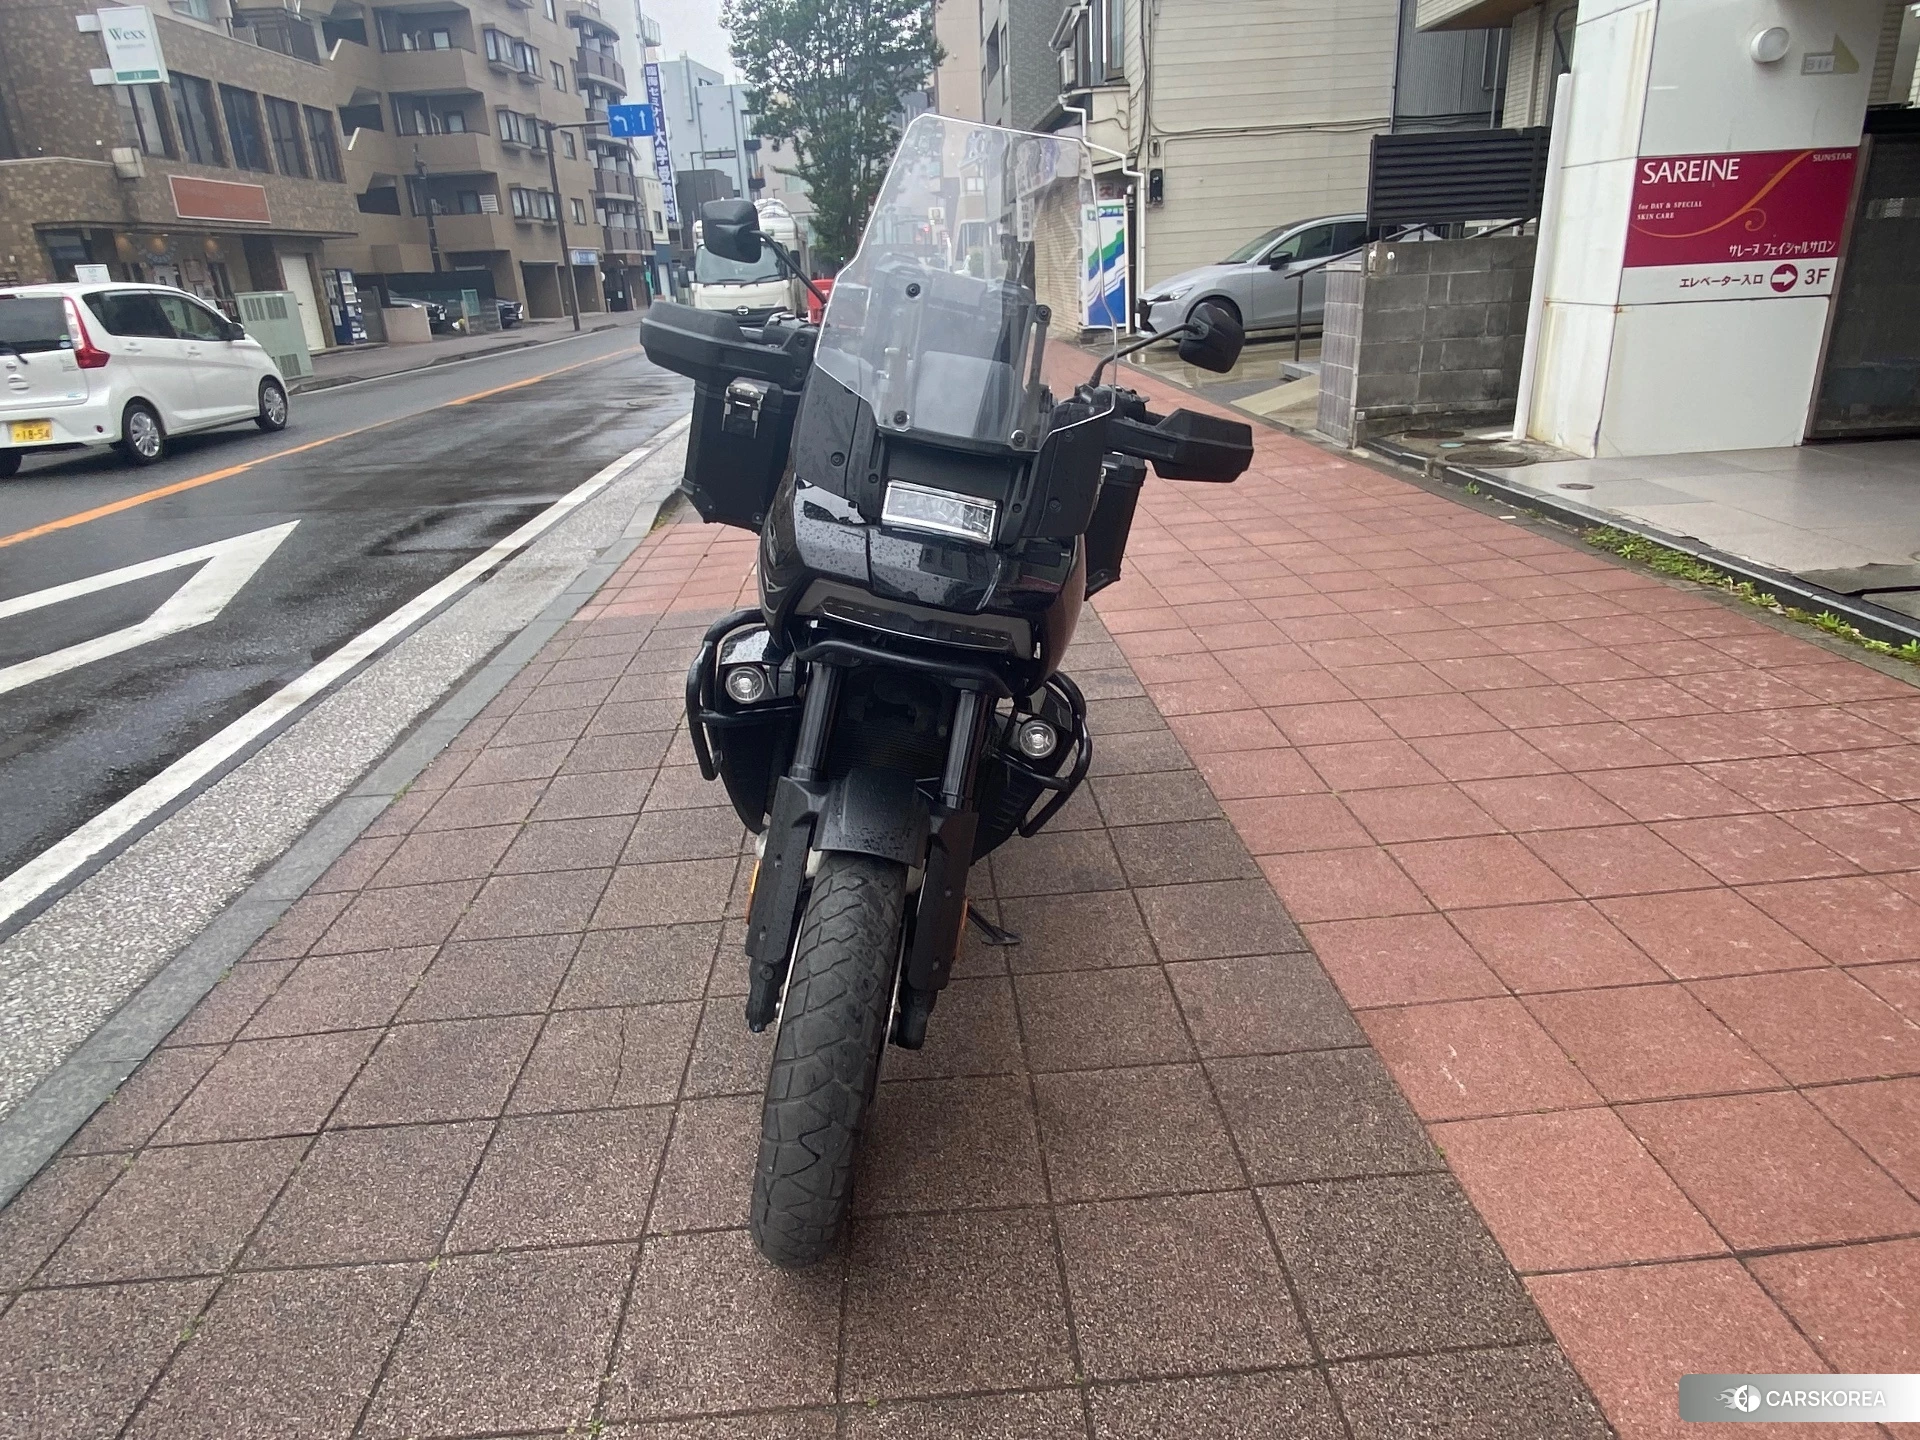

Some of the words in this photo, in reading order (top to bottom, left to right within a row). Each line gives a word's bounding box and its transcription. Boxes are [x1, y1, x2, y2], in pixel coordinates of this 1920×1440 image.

[108, 27, 146, 40] Wexx
[1812, 152, 1852, 162] SUNSTAR
[1642, 158, 1741, 184] SAREINE
[1655, 212, 1675, 220] CARE
[1729, 243, 1760, 258] サレーヌ
[1763, 240, 1836, 256] フェイシャルサロン
[1679, 273, 1764, 289] エレベーター入口
[1804, 268, 1830, 285] 3F
